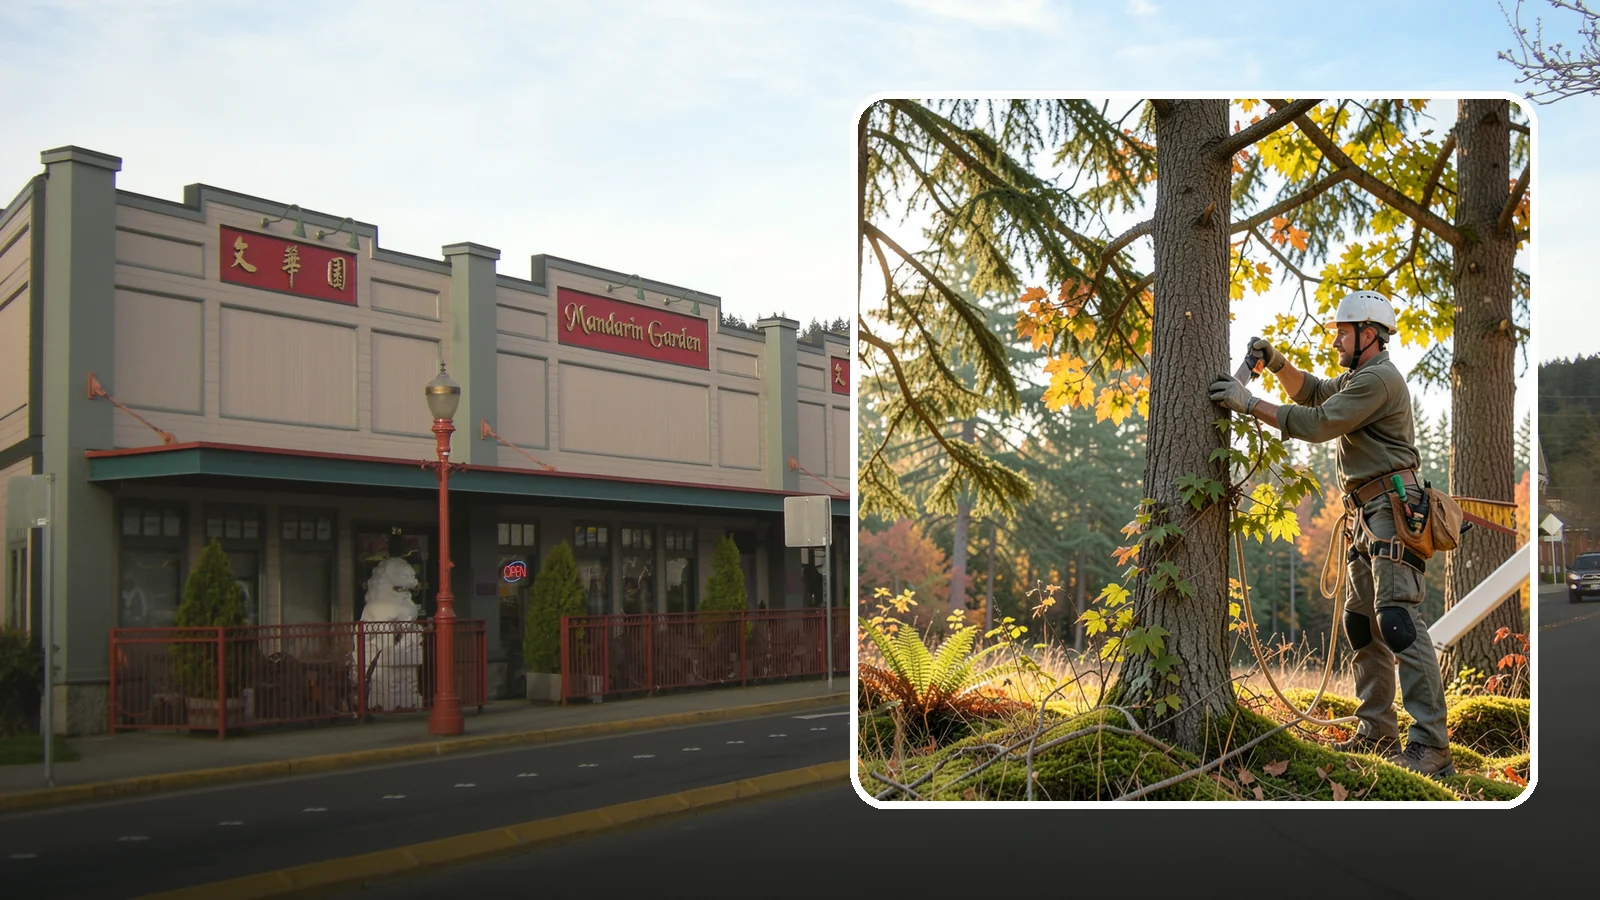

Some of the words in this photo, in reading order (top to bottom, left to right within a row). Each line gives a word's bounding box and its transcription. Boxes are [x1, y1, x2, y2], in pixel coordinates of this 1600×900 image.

[230, 235, 347, 291] 文華園
[564, 303, 643, 340] Mandarin
[648, 320, 701, 351] Garden
[503, 565, 527, 578] OPEN
